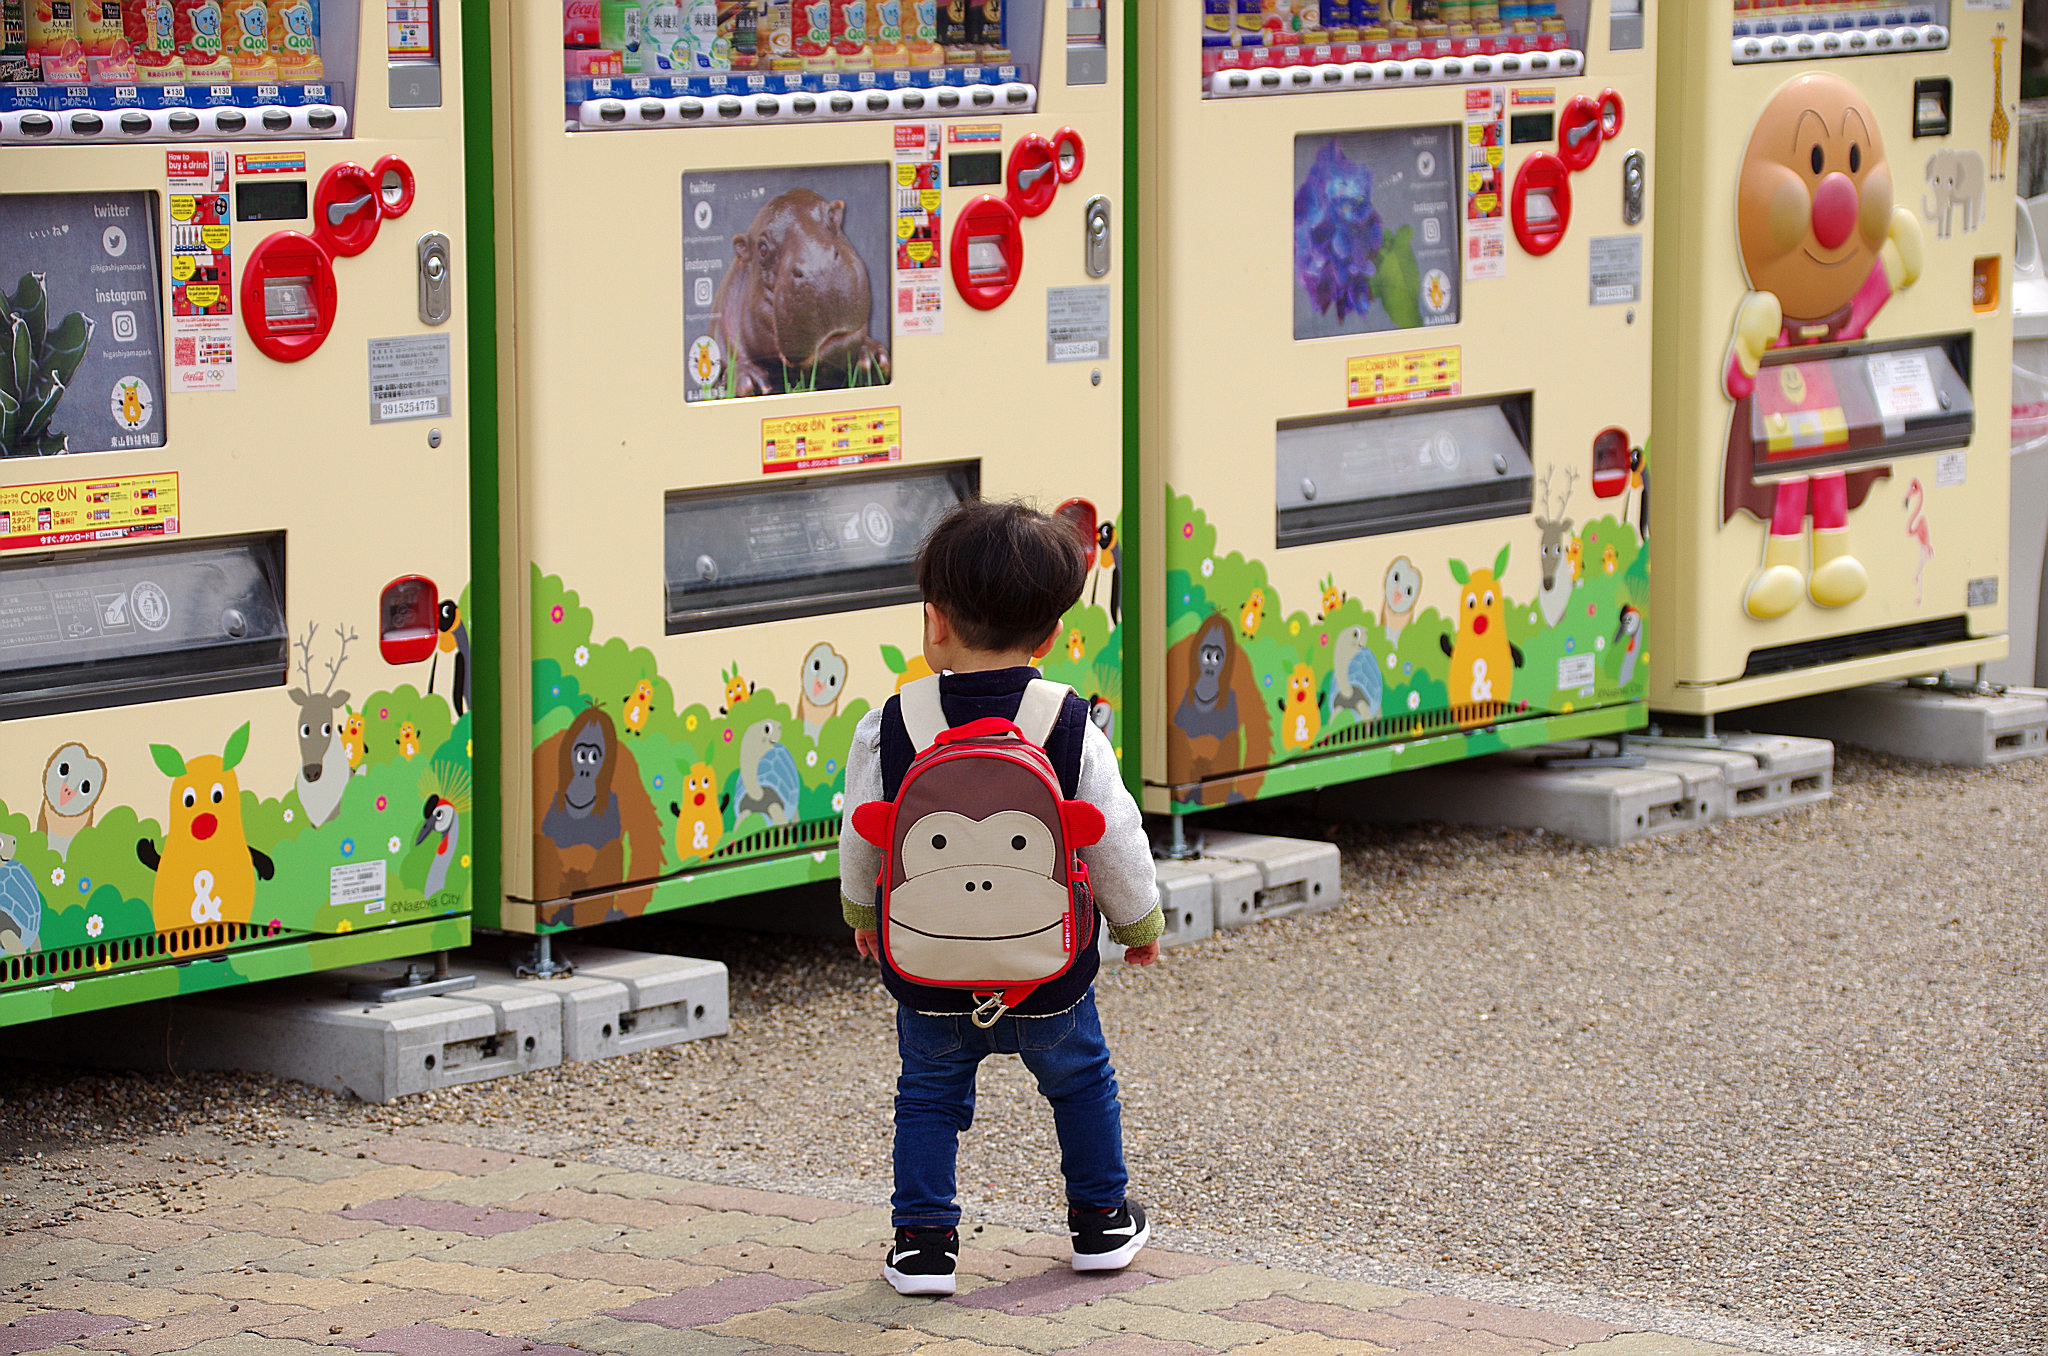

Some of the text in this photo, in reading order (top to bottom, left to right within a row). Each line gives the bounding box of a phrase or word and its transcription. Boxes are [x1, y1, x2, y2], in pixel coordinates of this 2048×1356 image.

[195, 37, 220, 49] Qoo
[243, 37, 267, 49] Qoo
[287, 37, 313, 49] Qoo
[18, 88, 37, 97] ¥130
[68, 88, 87, 97] ¥130
[118, 88, 135, 97] ¥130
[166, 88, 183, 96] ¥130
[213, 87, 230, 95] ¥130
[259, 87, 277, 95] ¥130
[305, 87, 323, 95] ¥130
[168, 161, 182, 170] buy
[188, 160, 208, 169] drink
[94, 203, 131, 218] twitter
[95, 288, 147, 306] instagram
[382, 399, 437, 416] 3915254775
[20, 484, 77, 505] Coke ON
[1471, 658, 1493, 703] &
[190, 870, 223, 924] &
[440, 892, 462, 906] City
